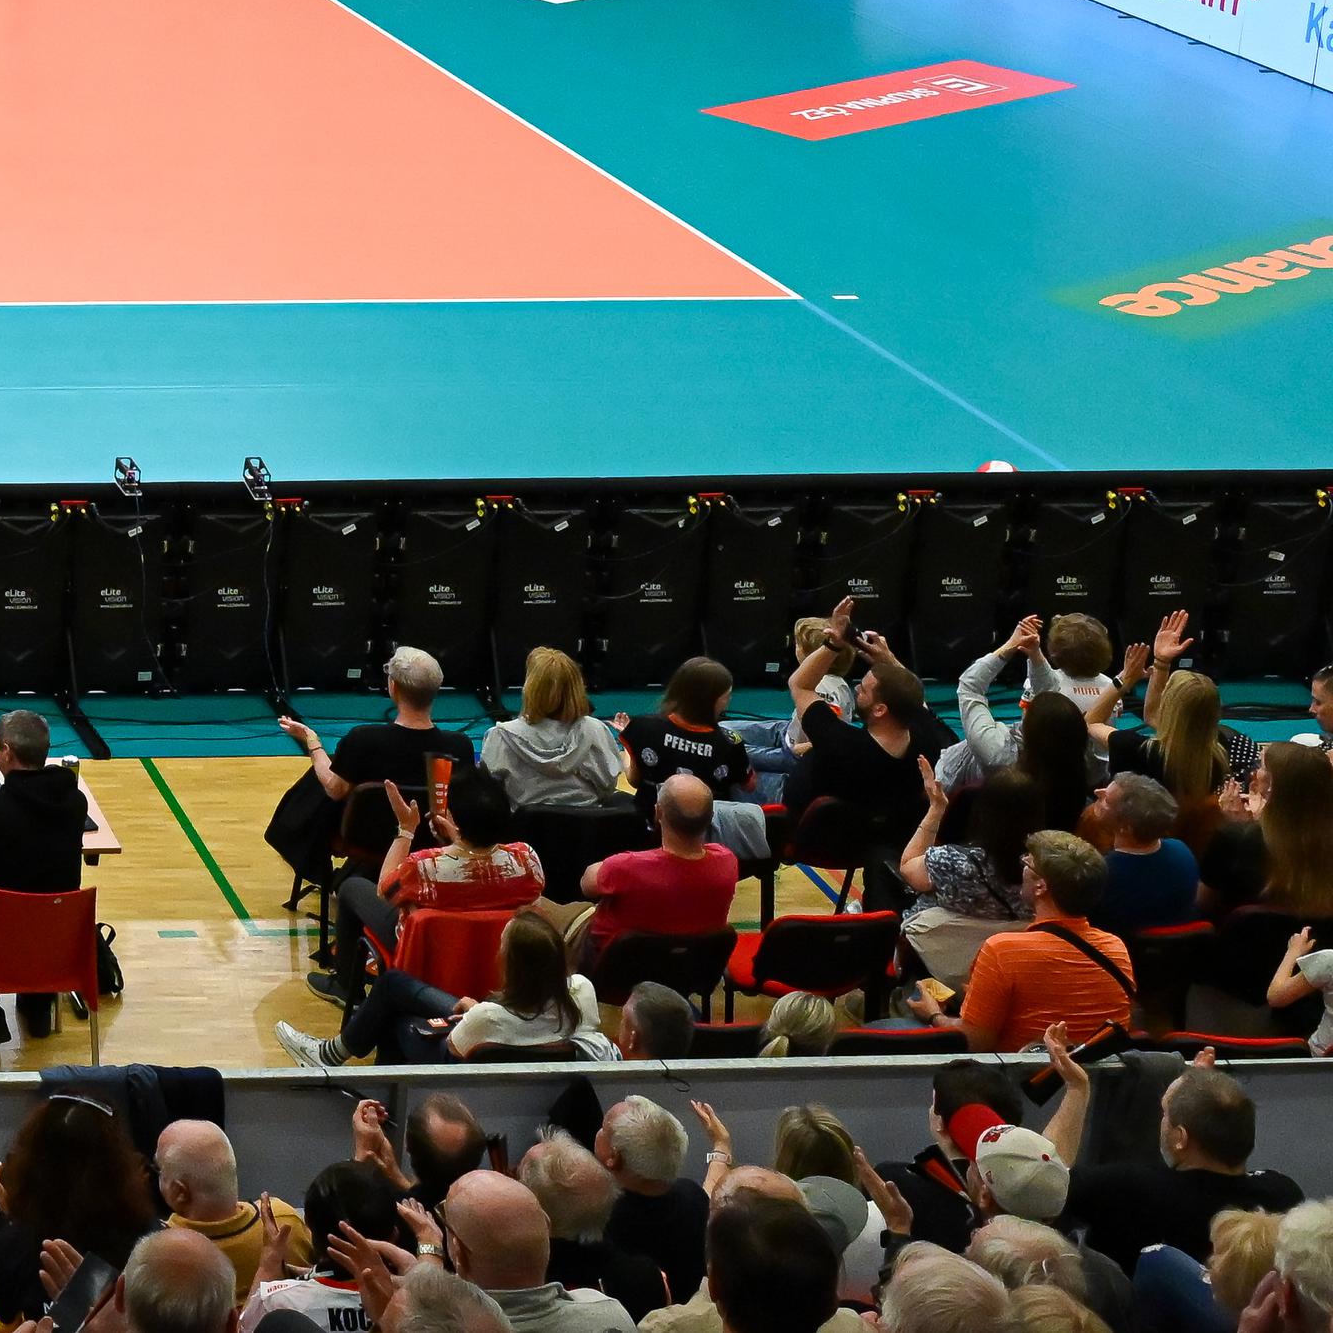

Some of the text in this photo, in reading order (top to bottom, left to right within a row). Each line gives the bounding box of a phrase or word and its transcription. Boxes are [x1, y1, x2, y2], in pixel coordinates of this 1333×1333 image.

[789, 87, 941, 121] SKUPINA ČEZ
[663, 732, 714, 758] PFEFFER
